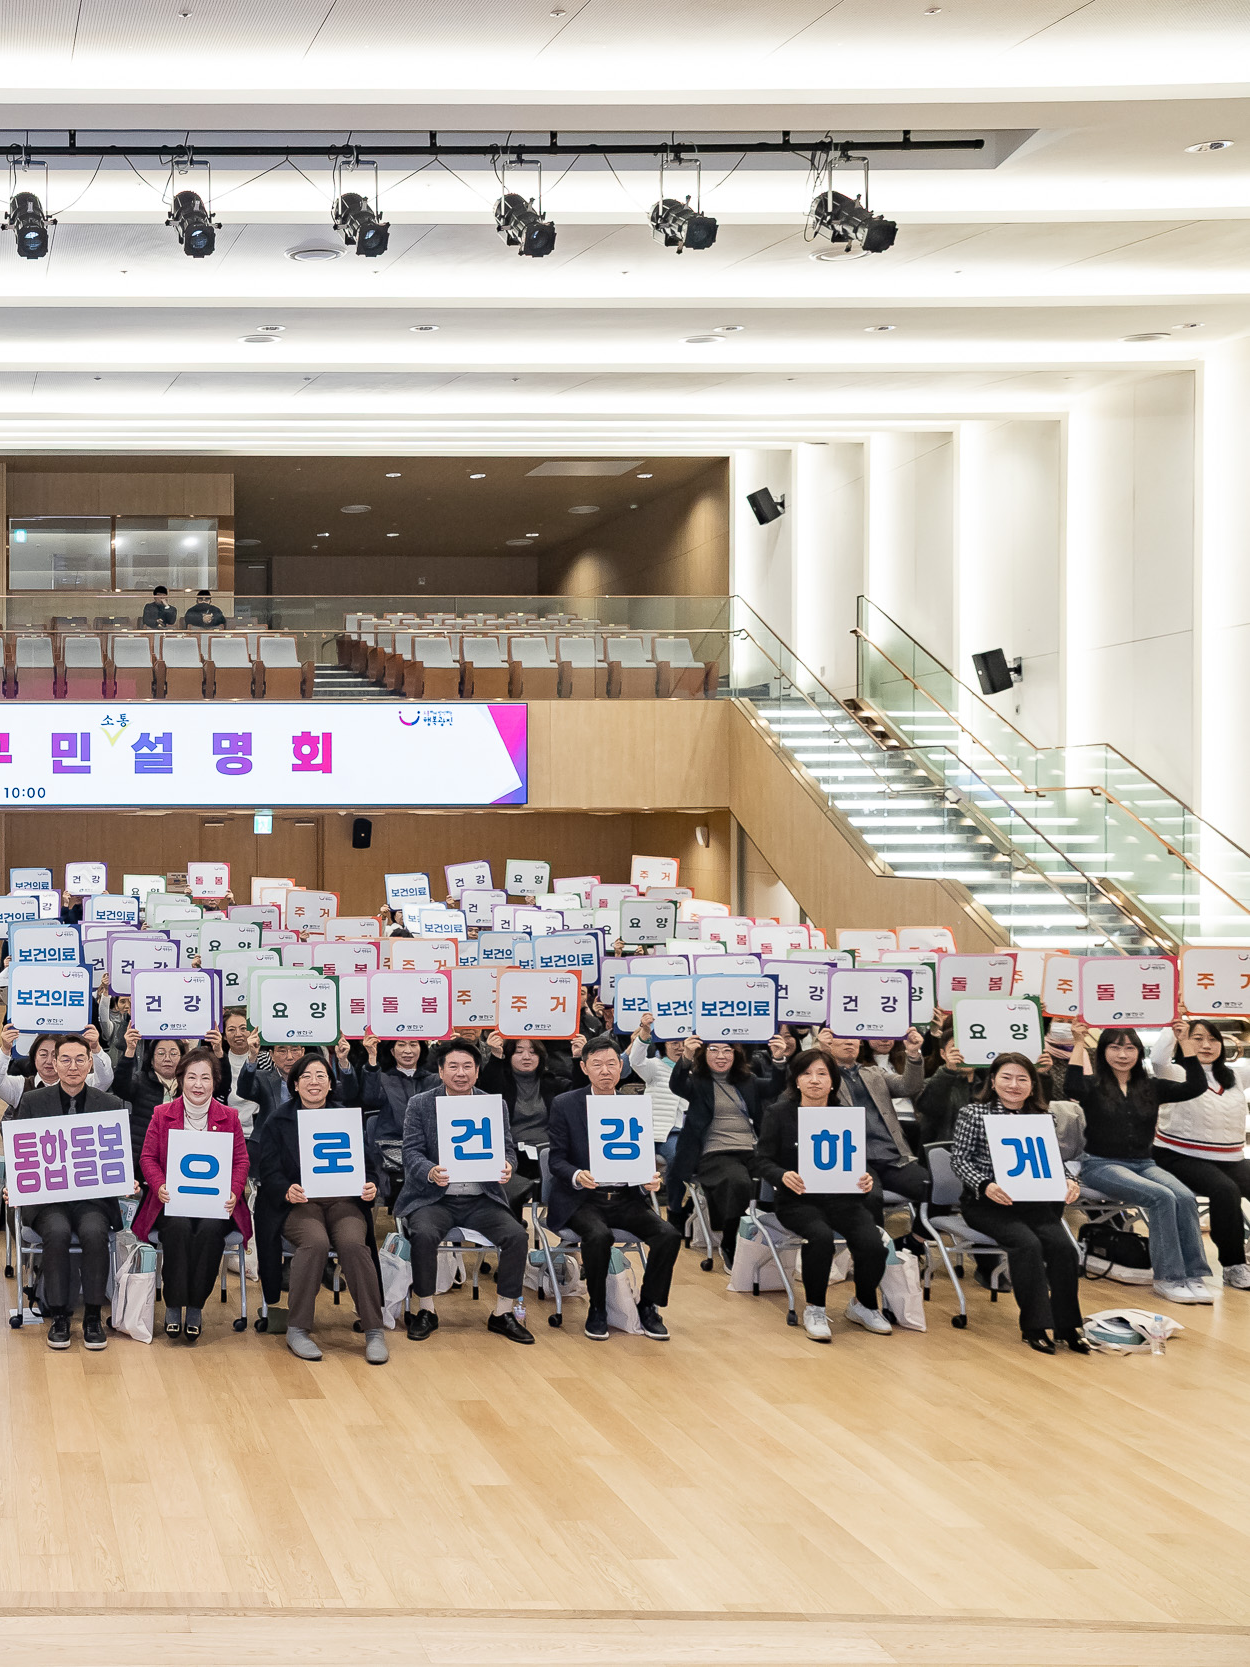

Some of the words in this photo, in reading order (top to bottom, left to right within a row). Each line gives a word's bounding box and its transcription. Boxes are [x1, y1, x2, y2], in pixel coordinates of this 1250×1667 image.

[101, 714, 130, 727] 소통
[4, 788, 45, 798] 10:00
[392, 887, 427, 897] 보건의료
[96, 911, 135, 921] 보건의료
[425, 924, 463, 933] 보건의료
[19, 948, 76, 962] 보건의료
[483, 949, 512, 960] 보건의
[540, 954, 594, 968] 보건의료
[460, 958, 477, 966] 보건
[17, 990, 84, 1006] 보건의료
[622, 998, 649, 1011] 보건
[658, 1000, 692, 1017] 보건
[701, 1001, 770, 1016] 보건의료
[451, 1117, 493, 1160] 건
[600, 1117, 643, 1160] 강
[313, 1132, 354, 1174] 로
[811, 1130, 857, 1171] 하
[1001, 1137, 1052, 1178] 게
[13, 1123, 125, 1193] 통합돌봄
[178, 1154, 219, 1195] 으
